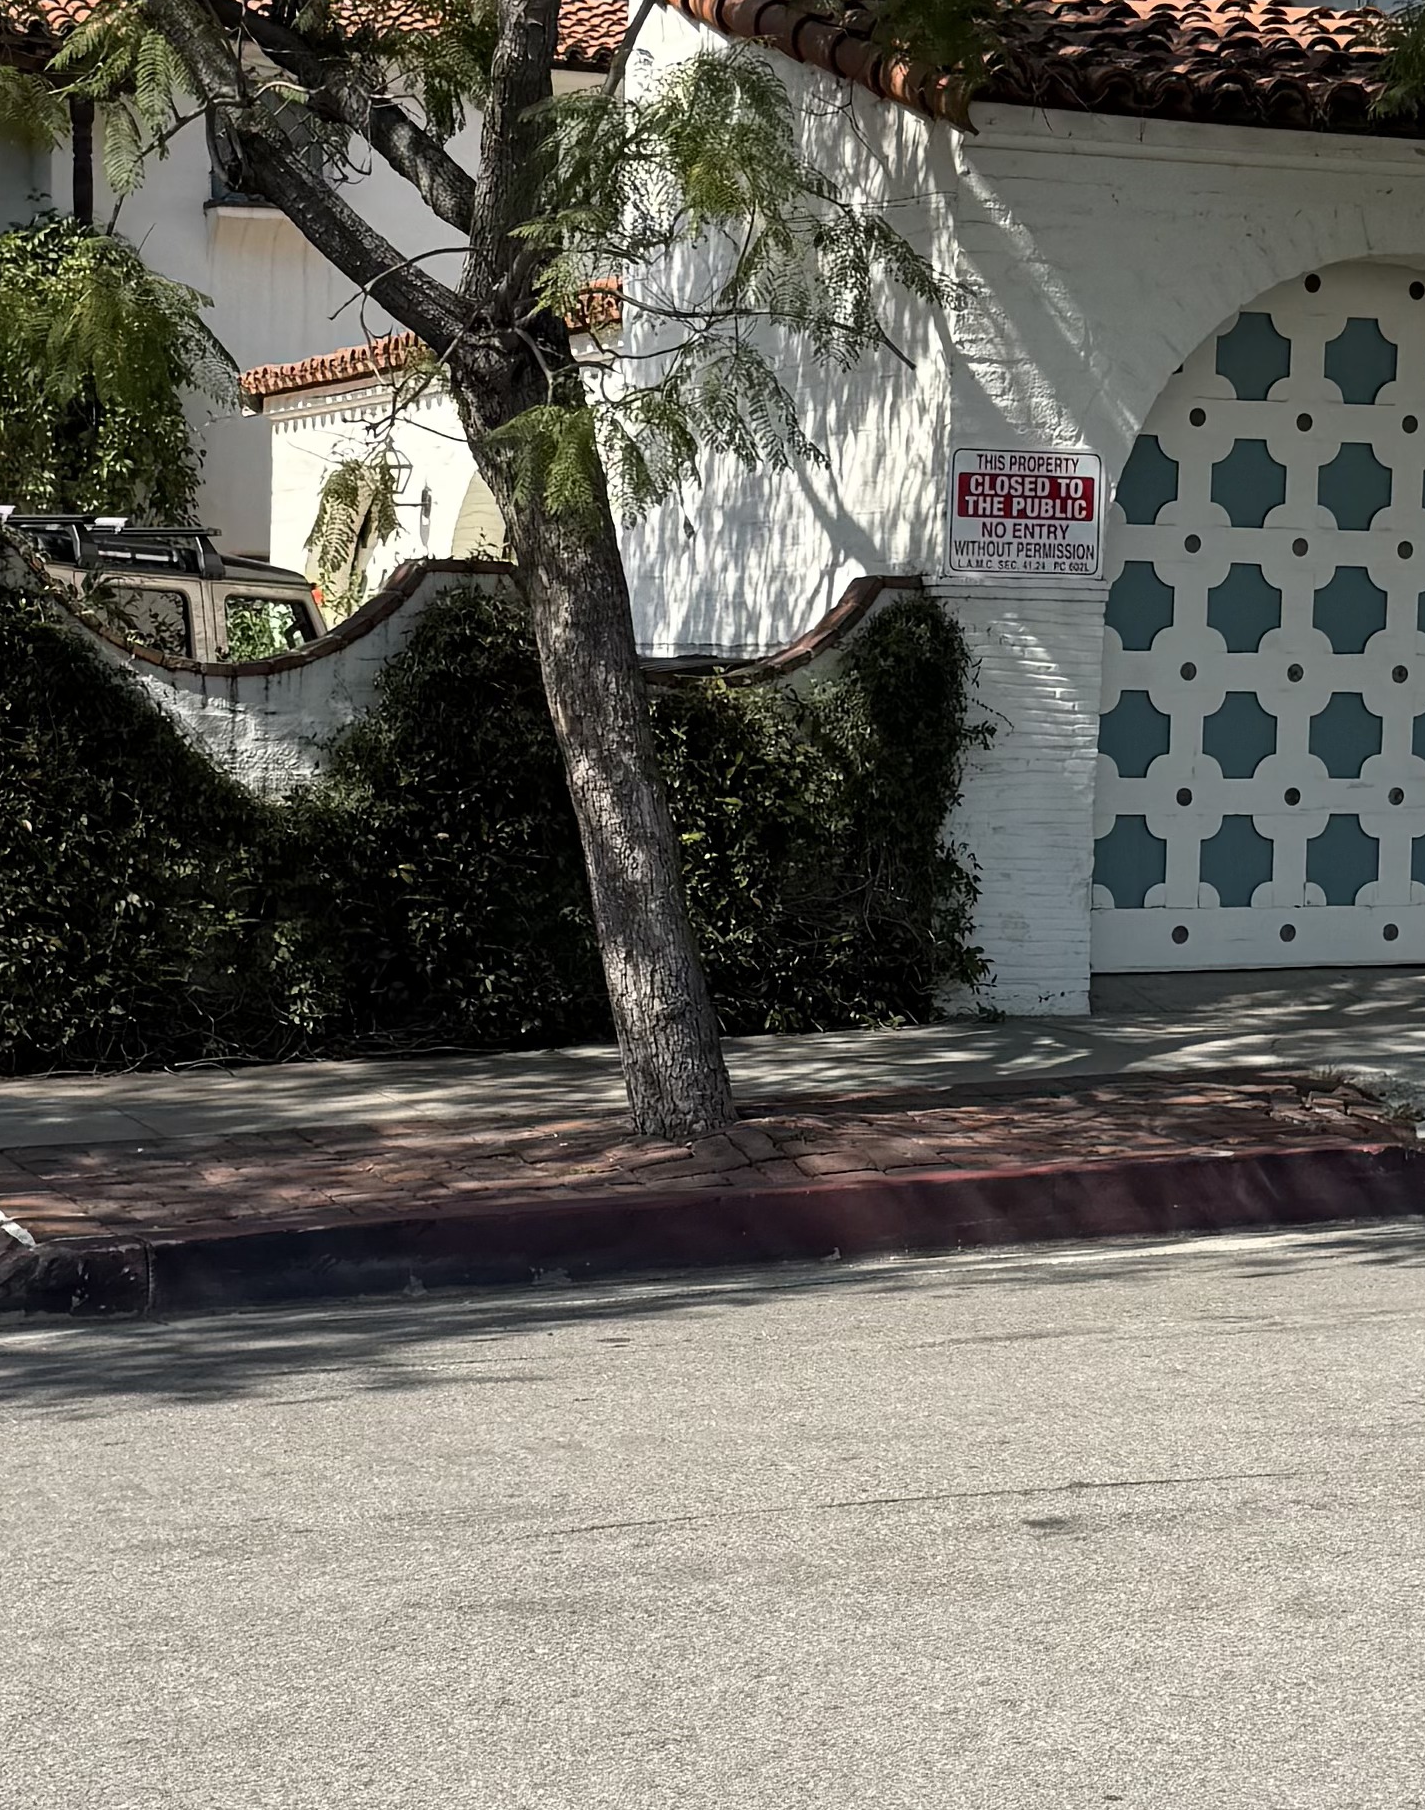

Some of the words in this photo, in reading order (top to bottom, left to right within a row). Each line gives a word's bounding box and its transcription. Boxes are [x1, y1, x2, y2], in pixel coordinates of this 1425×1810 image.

[977, 454, 1005, 471] THIS
[1010, 455, 1079, 474] PROPERTY
[970, 475, 1050, 497] CLOSED
[1057, 478, 1083, 498] TO
[965, 496, 1004, 516] THE
[1012, 497, 1087, 519] PUBLIC
[982, 521, 1006, 539] NO
[1013, 523, 1069, 540] ENTRY
[954, 540, 1013, 558] WITHOUT
[1017, 542, 1094, 560] PERMISSION
[1054, 561, 1066, 571] PC
